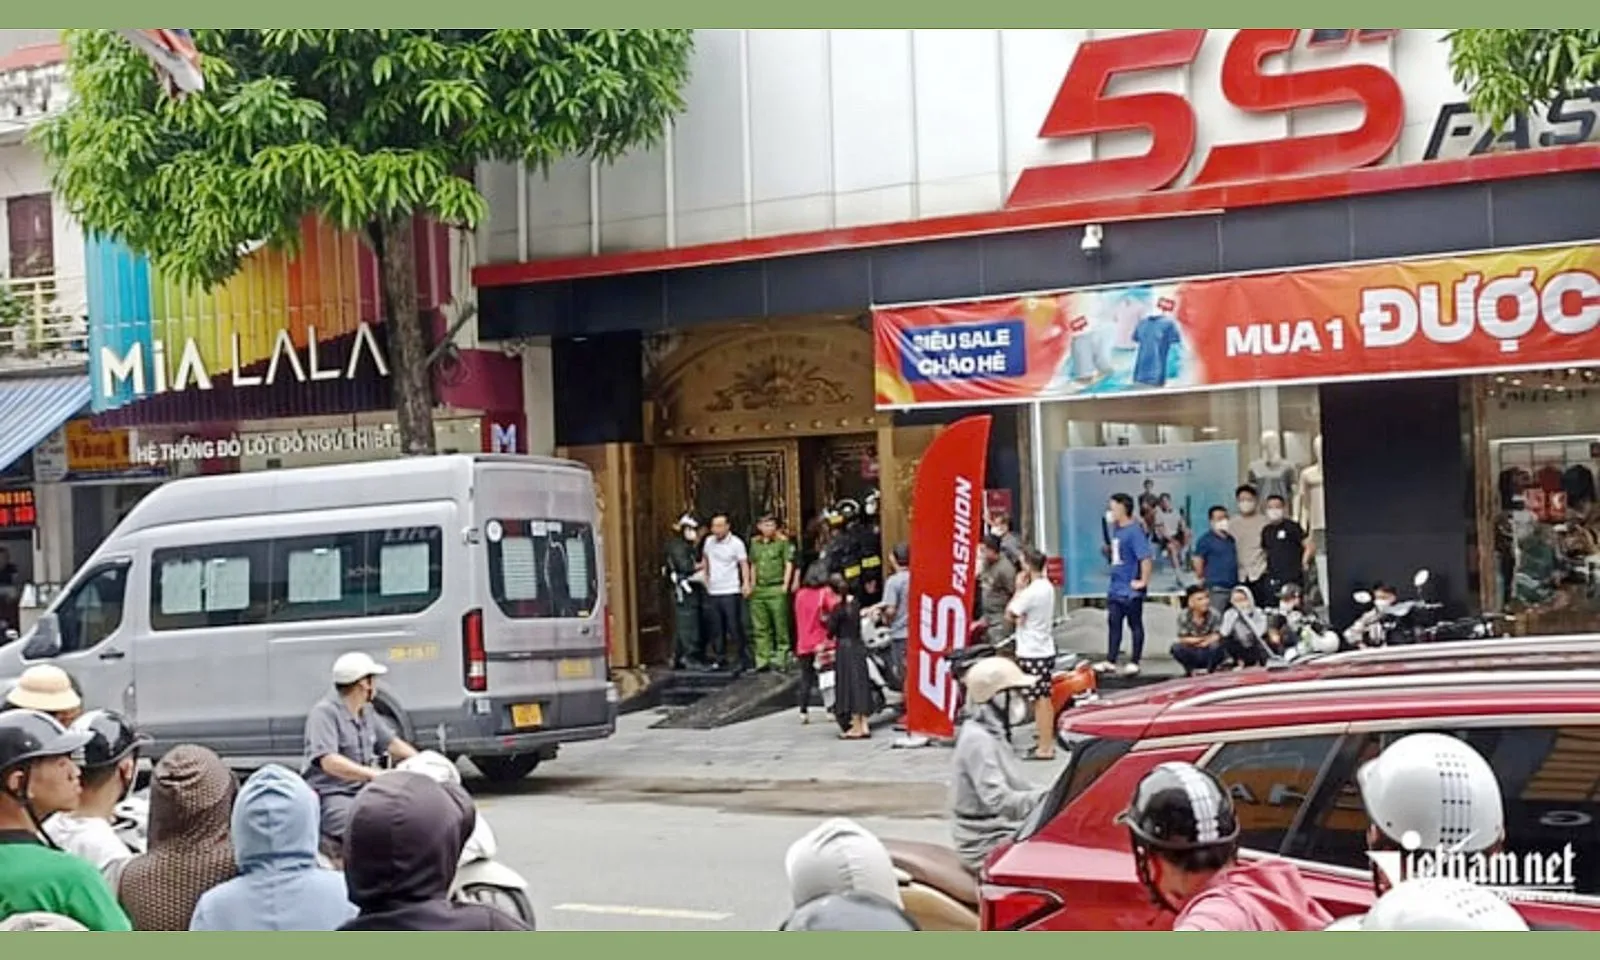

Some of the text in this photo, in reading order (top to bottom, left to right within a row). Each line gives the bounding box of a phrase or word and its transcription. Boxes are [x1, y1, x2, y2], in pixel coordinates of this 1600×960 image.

[1005, 29, 1405, 208] 5S
[1226, 269, 1600, 357] MUA 1 ĐƯỢC
[232, 322, 389, 386] LALA
[959, 328, 1010, 349] SALE
[917, 350, 1006, 376] CHÀO HÈ
[136, 439, 158, 466] HỆ
[160, 435, 214, 461] THỐNG
[491, 423, 516, 454] M
[952, 475, 972, 595] FASHION
